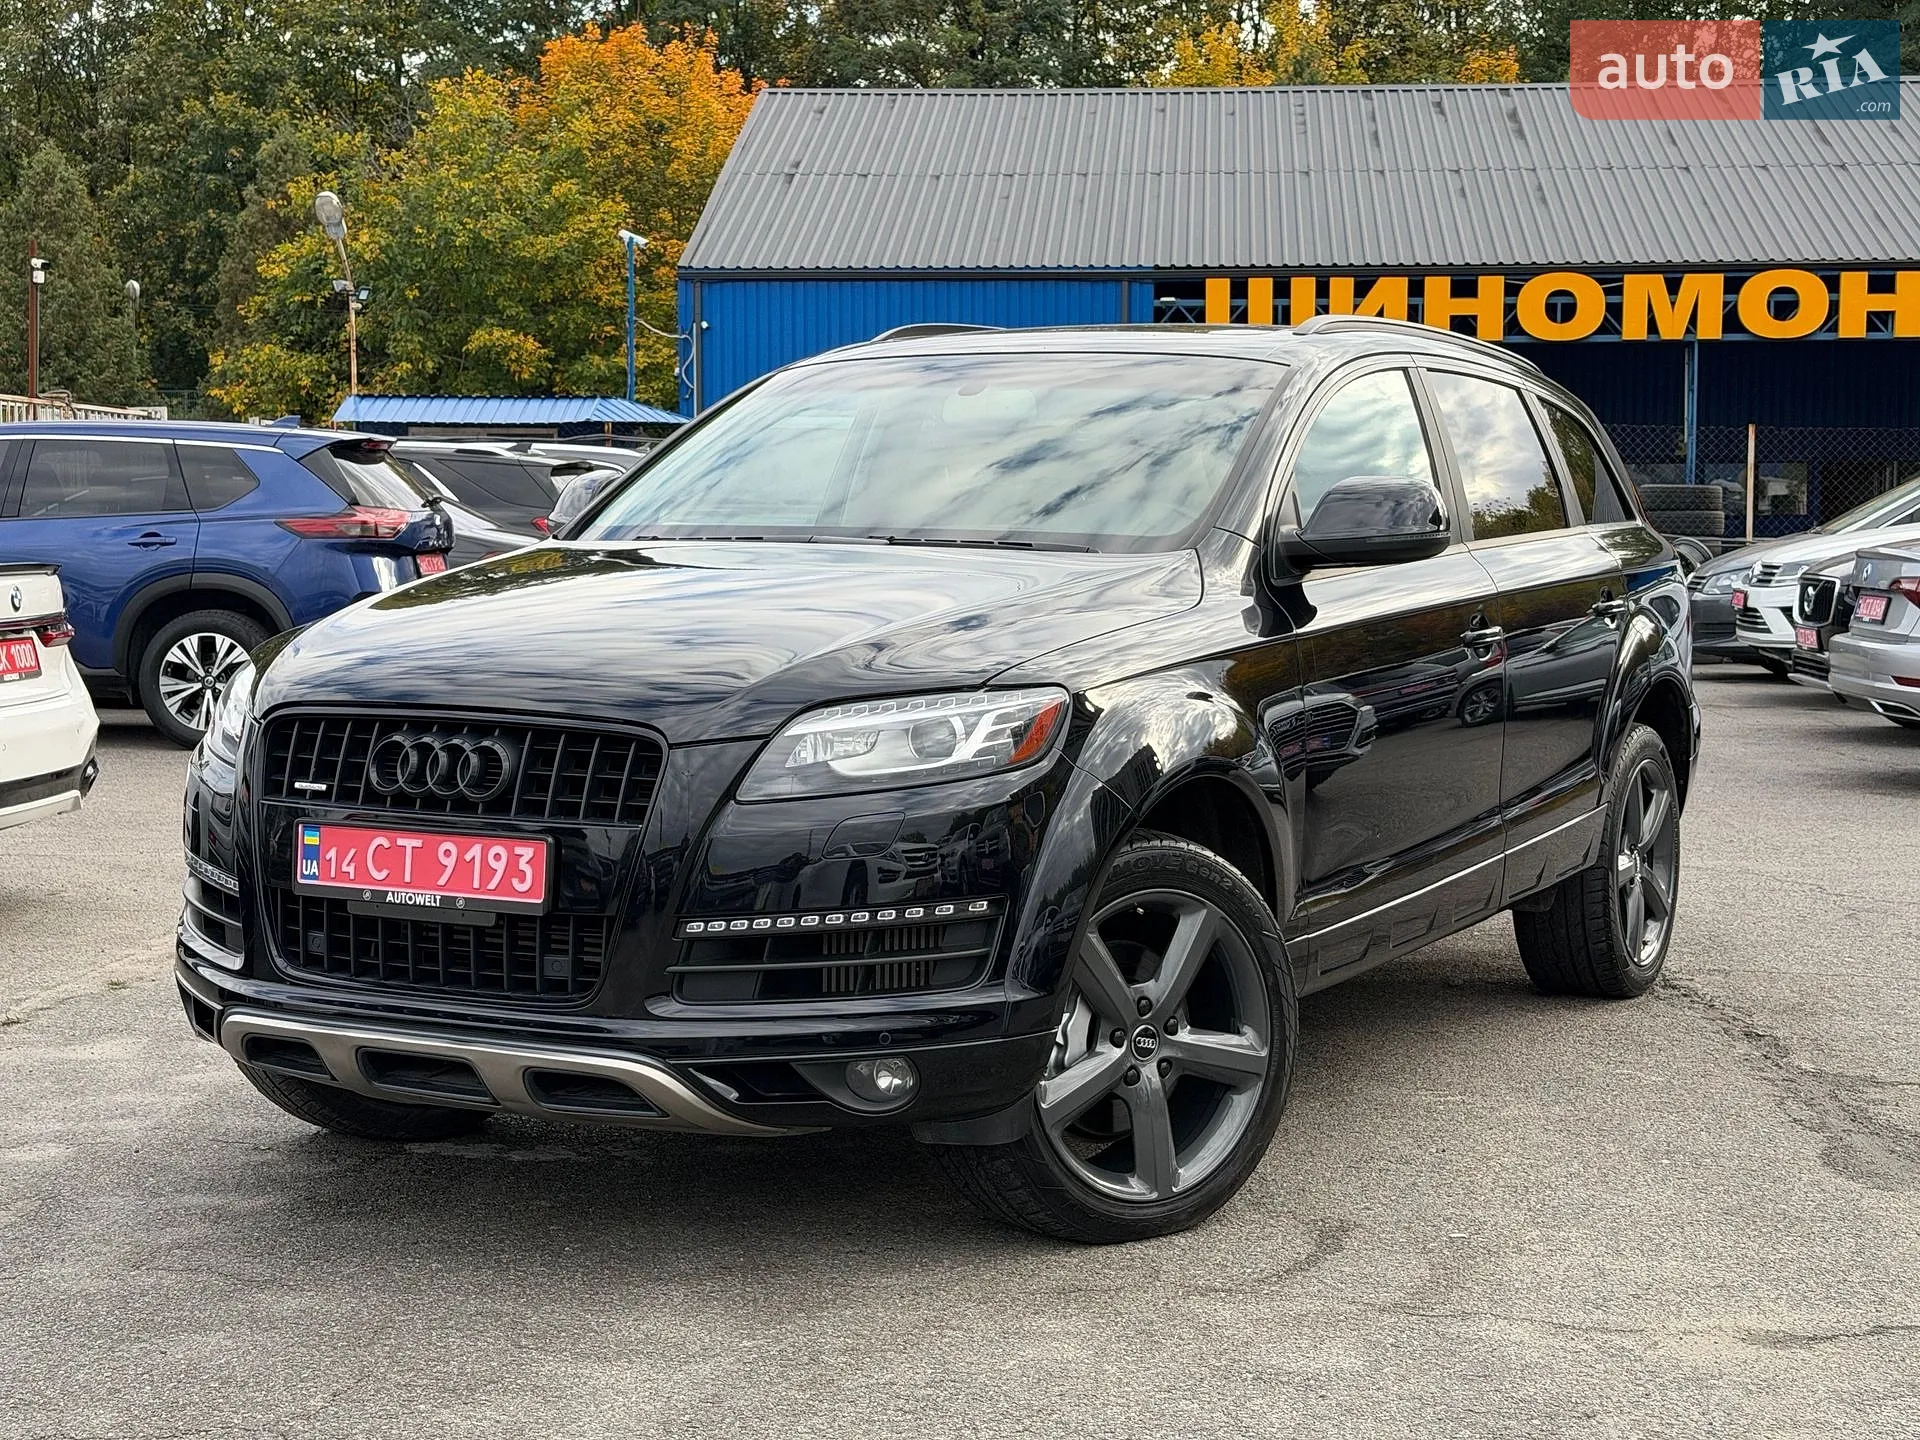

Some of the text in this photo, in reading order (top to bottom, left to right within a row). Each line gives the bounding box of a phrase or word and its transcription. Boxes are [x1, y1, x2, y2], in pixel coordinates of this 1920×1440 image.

[1205, 268, 1920, 341] ШИНОМОН
[11, 643, 36, 669] 1000
[302, 858, 319, 876] UA
[436, 841, 535, 893] 9193
[385, 891, 442, 907] AUTOWELT
